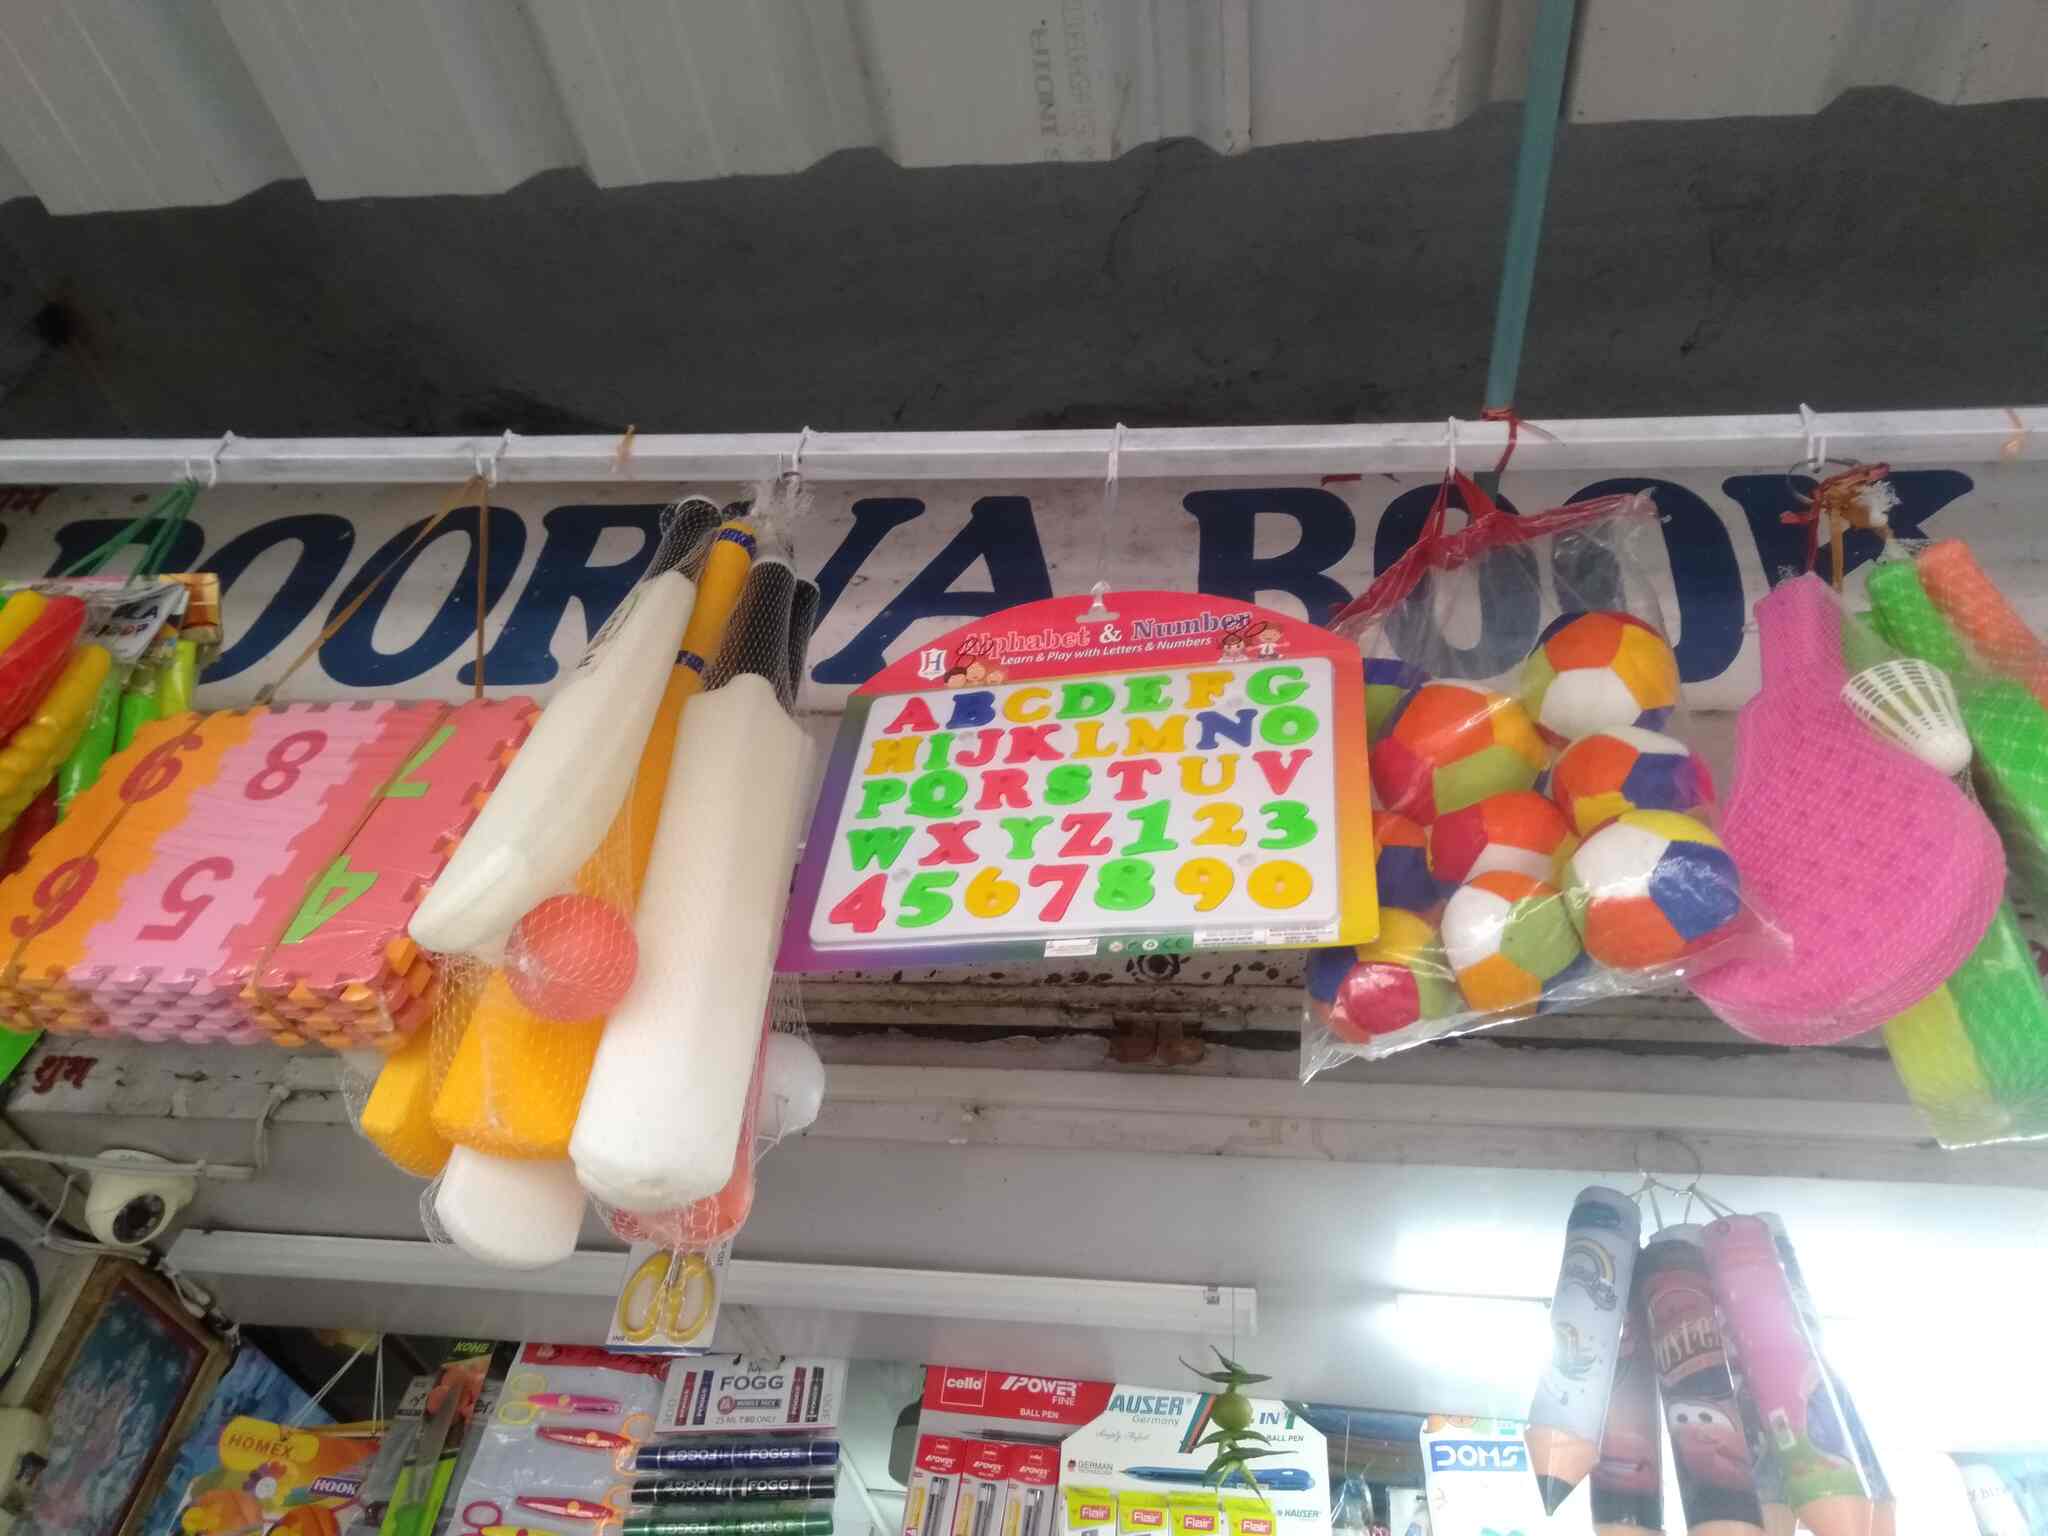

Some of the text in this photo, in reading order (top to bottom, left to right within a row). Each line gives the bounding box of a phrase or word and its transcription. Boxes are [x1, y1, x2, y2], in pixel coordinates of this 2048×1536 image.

[959, 611, 1251, 659] Alphabet & Number
[1001, 636, 1212, 665] Learn & Play with Letters & Numbers
[883, 666, 1310, 734] A B C D E F G
[863, 705, 1318, 775] H I J K L M N O
[244, 730, 327, 800] 8
[856, 749, 1313, 819] P Q R S T U V
[846, 800, 1318, 871] W X Y Z 1 2 3
[135, 857, 234, 941] 5
[281, 855, 380, 944] 4
[829, 873, 887, 933] 4
[896, 871, 959, 928] 5
[964, 867, 1020, 917] 6
[1029, 864, 1088, 922] 7
[1094, 858, 1156, 911] 8
[1175, 857, 1234, 911] 9
[720, 1376, 784, 1391] FOGG
[947, 1377, 982, 1390] cello
[1052, 1396, 1075, 1406] FINE
[1109, 1394, 1184, 1415] AUSER
[1020, 1408, 1059, 1419] BALL PEN
[1132, 1416, 1180, 1426] Germany
[1259, 1412, 1280, 1424] IN
[228, 1433, 293, 1458] HOMEX
[1435, 1445, 1520, 1467] DOMS
[1077, 1460, 1114, 1472] GERMAN
[313, 1478, 360, 1495] HOOK
[1081, 1506, 1108, 1519] Flair
[1133, 1511, 1161, 1523] Flair
[1185, 1517, 1213, 1529] Flair
[1242, 1521, 1271, 1533] Flair
